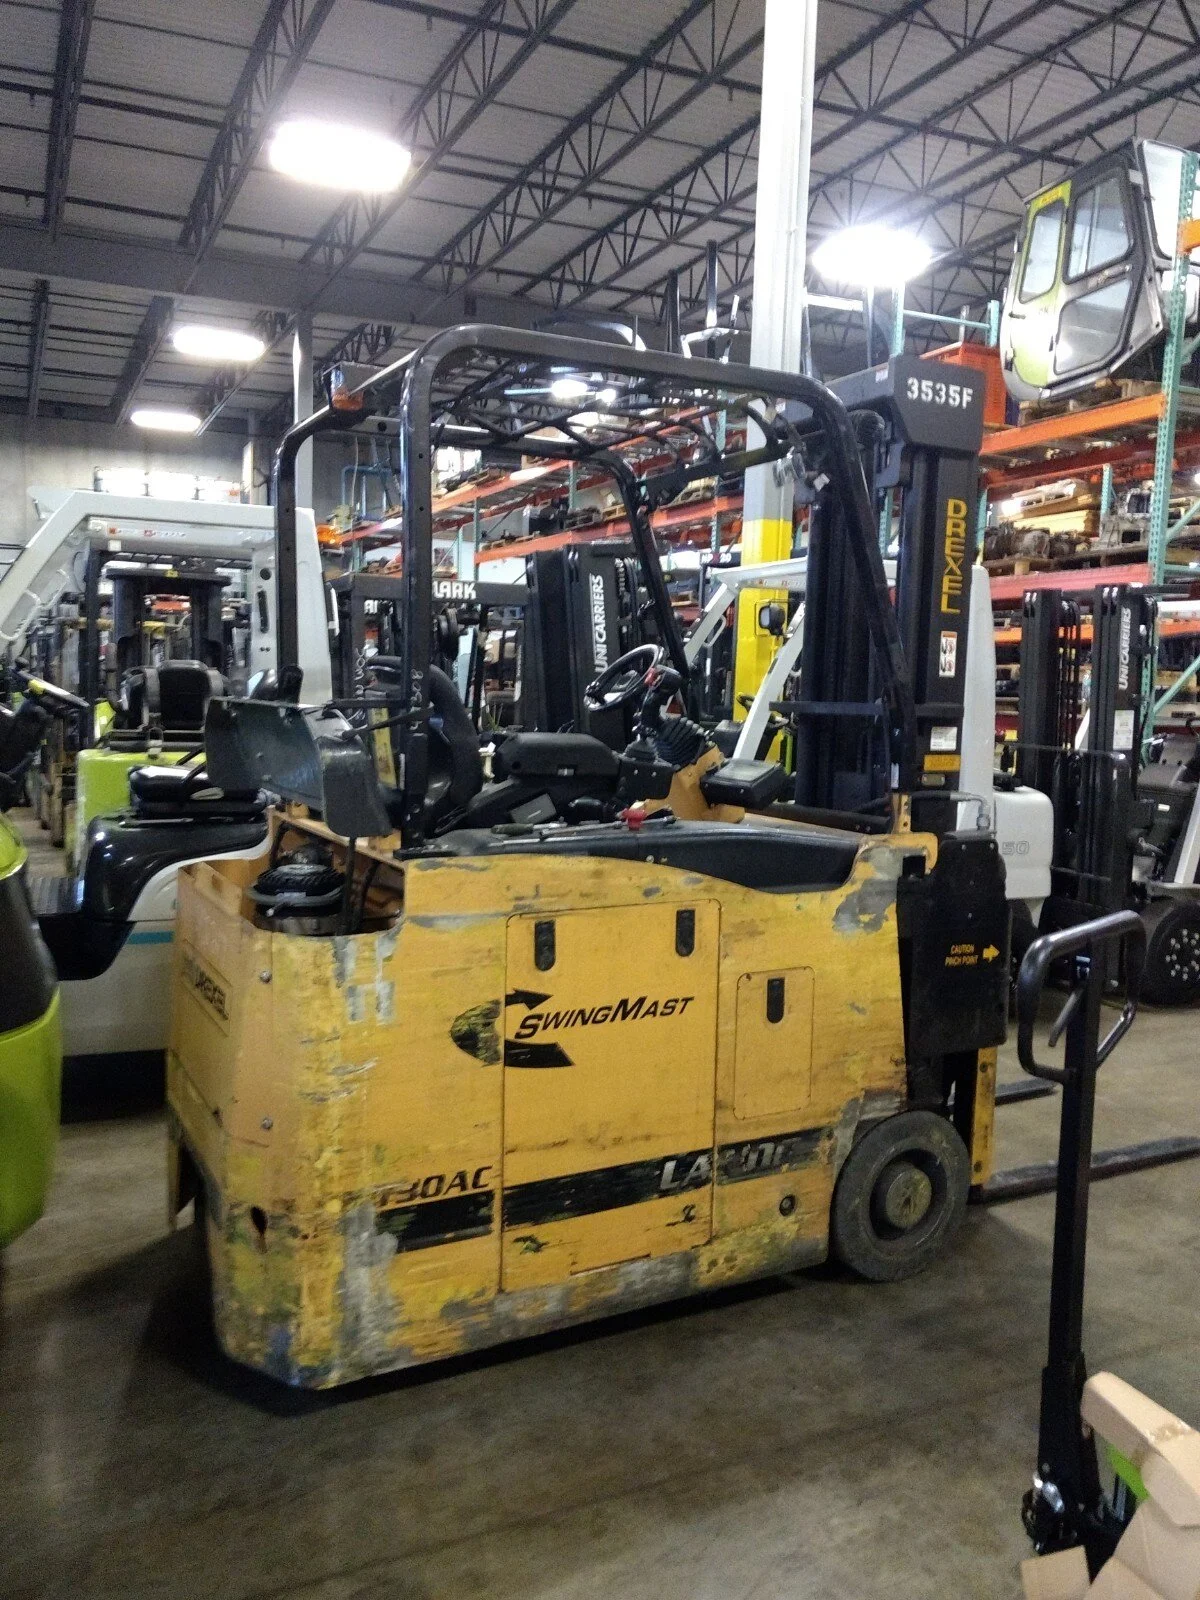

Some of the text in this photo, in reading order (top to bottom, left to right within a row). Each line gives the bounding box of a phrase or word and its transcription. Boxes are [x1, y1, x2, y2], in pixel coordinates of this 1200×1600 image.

[907, 376, 974, 410] 3535F
[940, 498, 968, 615] DREXEL
[433, 580, 477, 600] LARK
